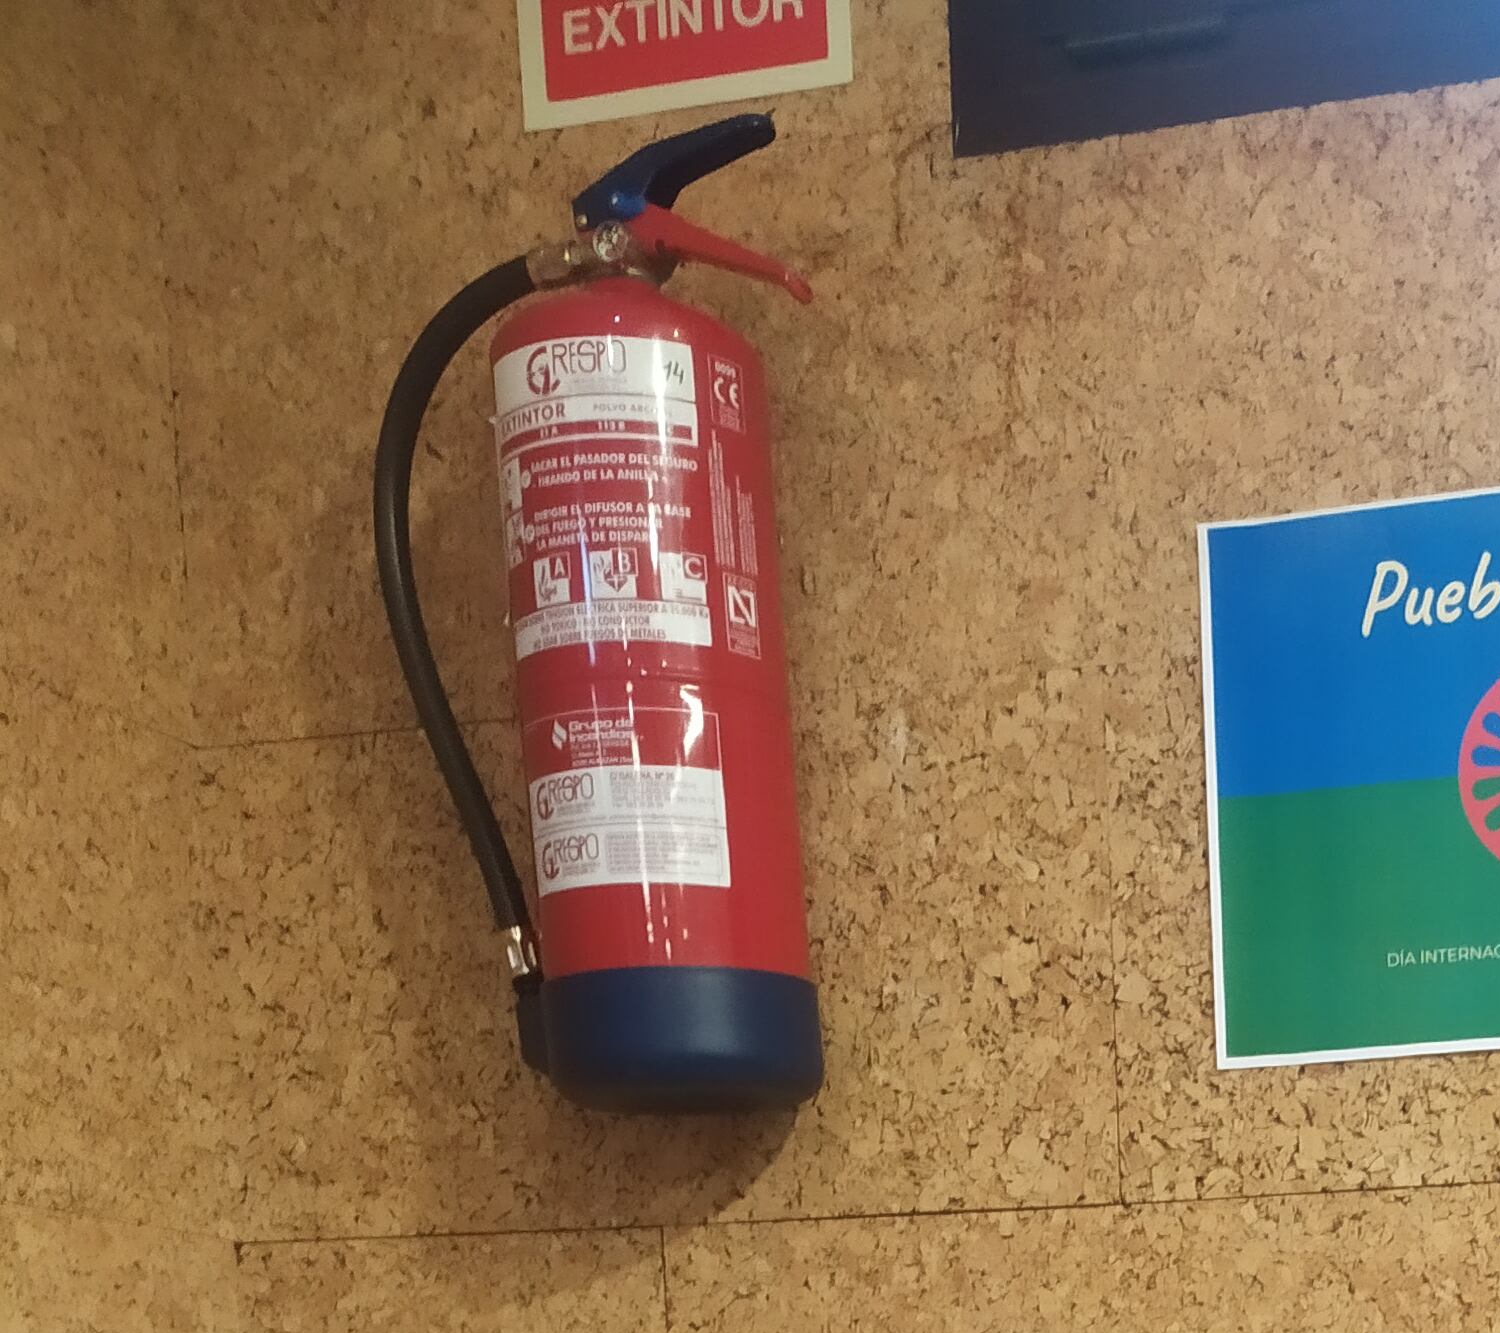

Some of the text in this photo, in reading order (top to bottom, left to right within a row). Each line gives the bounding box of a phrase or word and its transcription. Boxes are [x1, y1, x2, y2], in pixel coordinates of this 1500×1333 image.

[561, 456, 571, 467] EL
[574, 453, 626, 466] PASADOR
[629, 453, 649, 464] DEL
[584, 470, 597, 481] DE
[600, 469, 614, 479] LA
[585, 501, 633, 514] DIFUSOR
[636, 502, 644, 513] A
[590, 517, 595, 527] Y
[599, 516, 663, 529] PRESIONR
[592, 531, 606, 542] DE
[609, 530, 656, 542] DISPAR
[554, 559, 566, 576] A
[684, 557, 703, 577] C
[1387, 948, 1416, 968] DÍA
